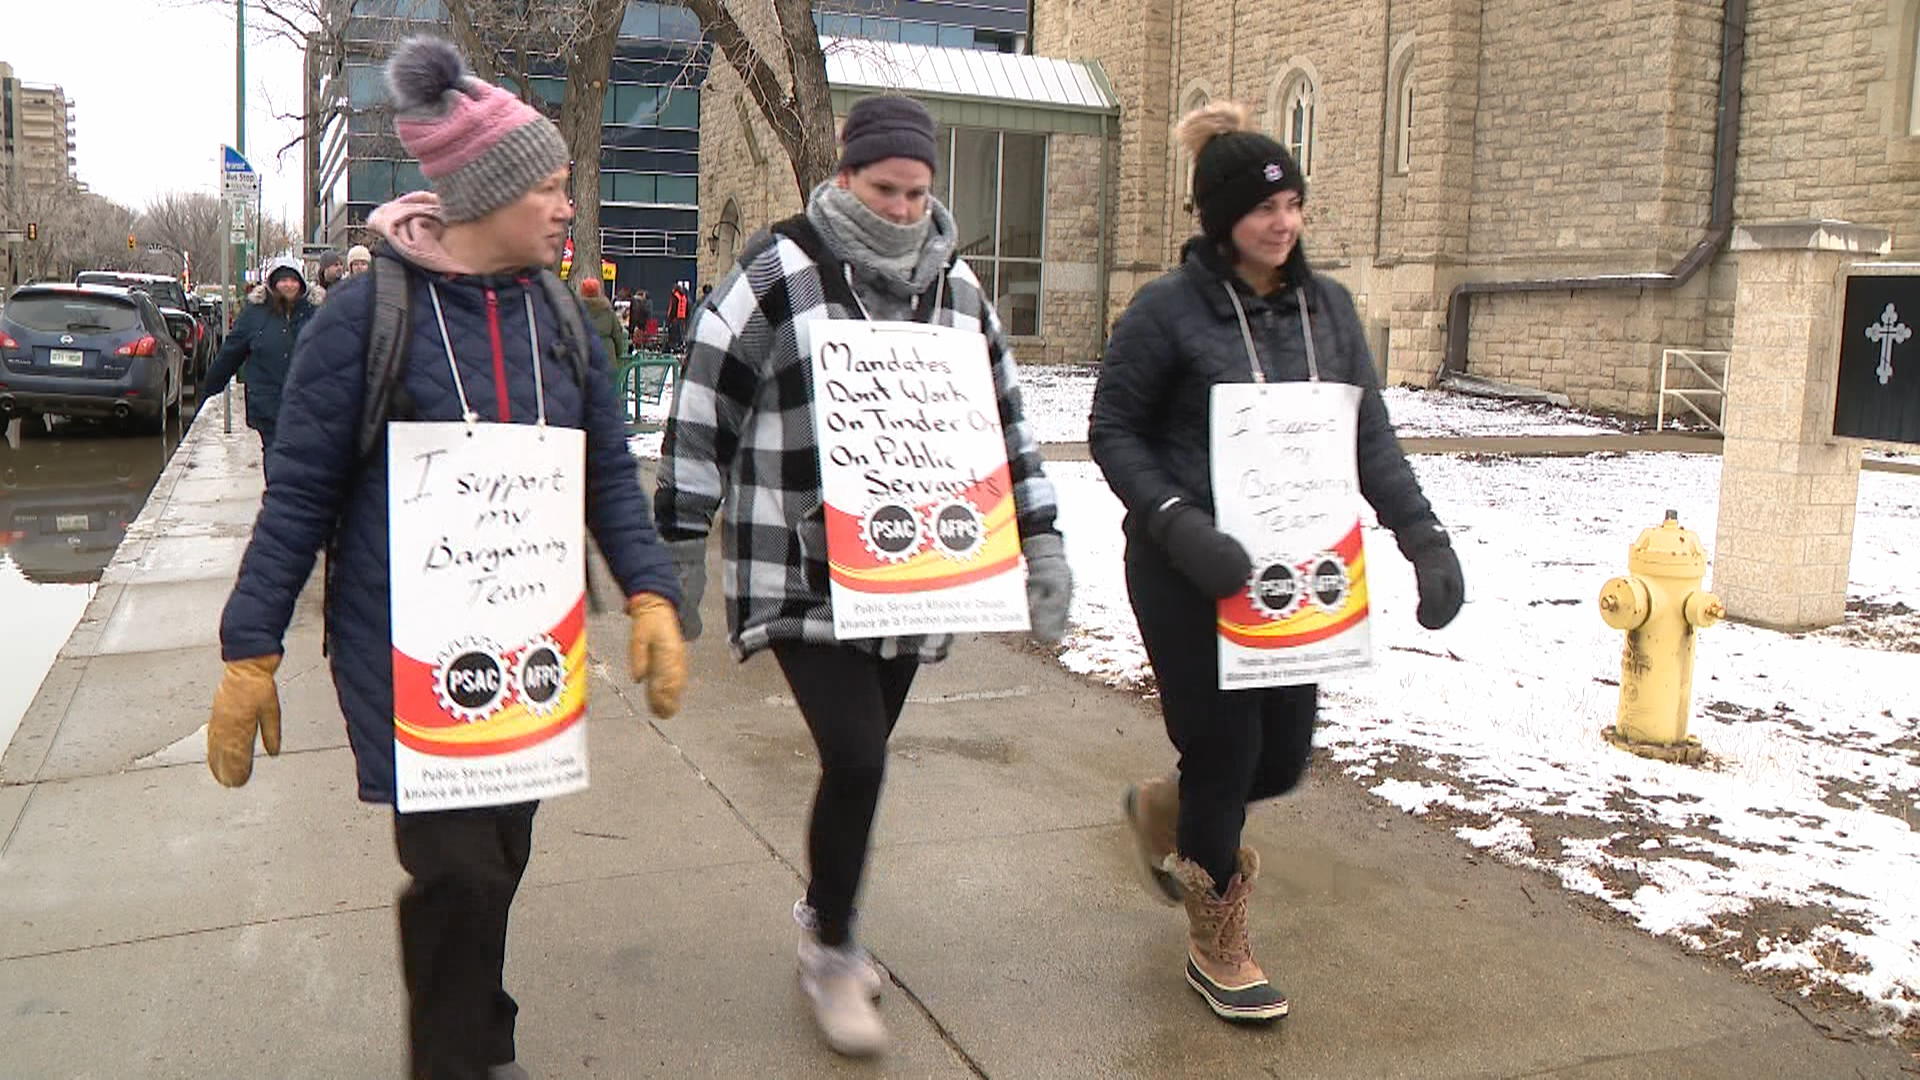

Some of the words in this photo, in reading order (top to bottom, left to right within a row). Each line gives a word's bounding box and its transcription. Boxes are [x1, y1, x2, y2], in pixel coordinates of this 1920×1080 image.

[239, 173, 254, 183] Stop
[820, 340, 952, 374] Mandates
[899, 377, 969, 404] Work
[826, 412, 864, 433] On
[862, 408, 960, 433] Tinder
[830, 444, 870, 467] On
[874, 435, 956, 470] Public
[402, 448, 448, 505] I
[454, 467, 567, 503] support
[863, 467, 1002, 498] Servants
[473, 506, 532, 532] my
[871, 519, 916, 541] PSAC
[939, 518, 979, 540] AFPC
[423, 535, 568, 574] Bargaining
[467, 574, 547, 608] Team
[448, 664, 500, 694] PSAC
[524, 662, 562, 690] AFPC
